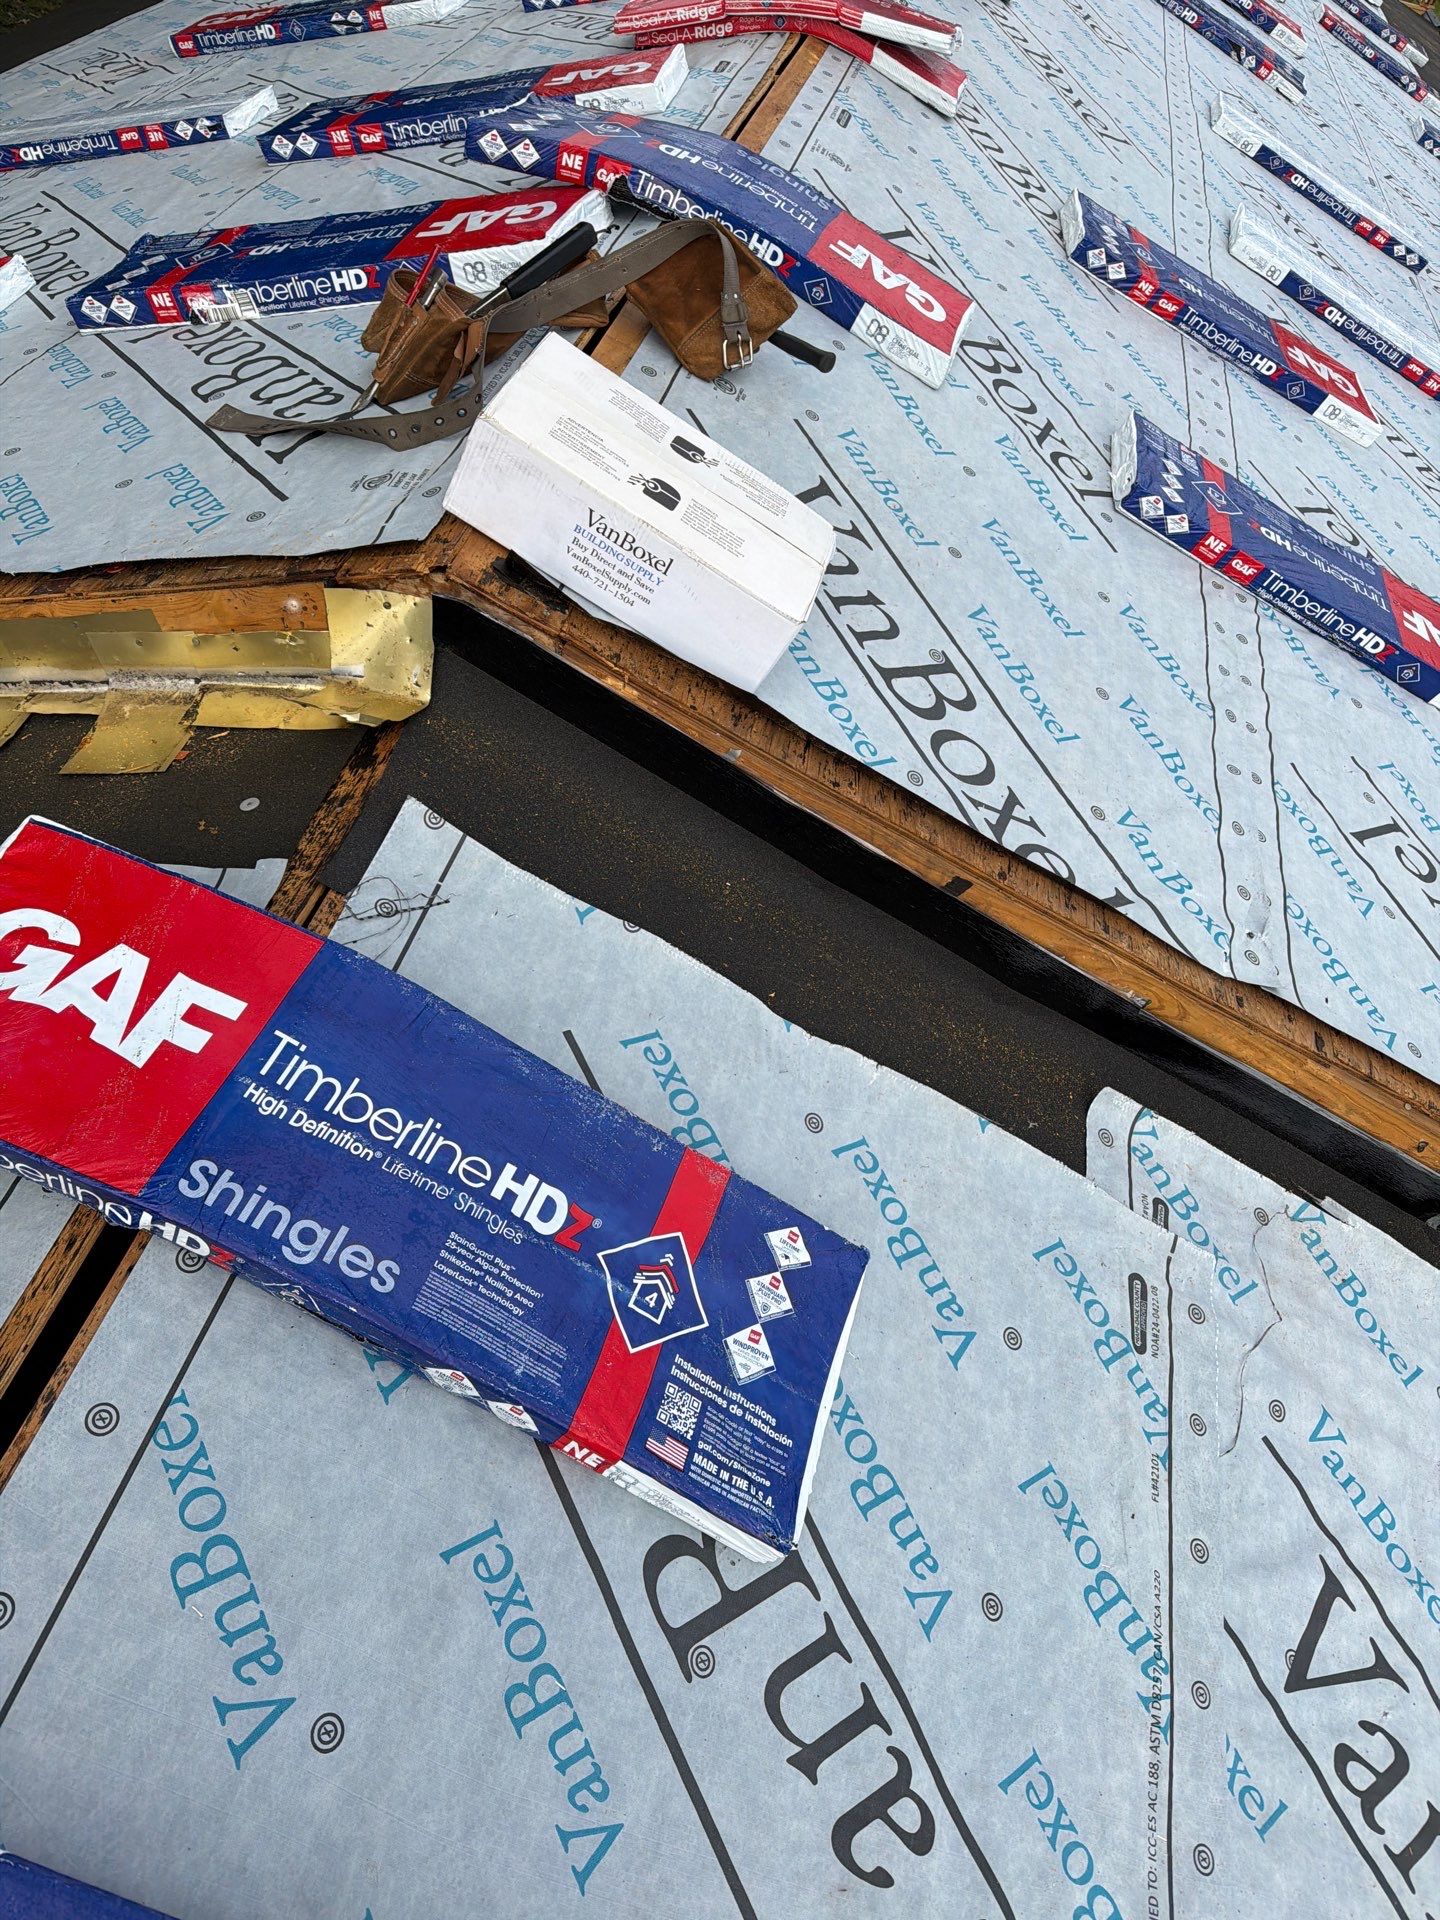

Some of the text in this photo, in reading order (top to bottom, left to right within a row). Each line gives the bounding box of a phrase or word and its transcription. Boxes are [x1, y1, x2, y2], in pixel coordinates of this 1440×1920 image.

[178, 41, 194, 49] GAF
[368, 11, 382, 21] NE
[651, 21, 734, 44] Seal-A-Ridge
[331, 113, 468, 145] NE GAF Timberlin
[561, 152, 583, 170] NE
[596, 168, 622, 188] GA
[930, 158, 999, 233] VanBoxel
[416, 200, 557, 238] GAF
[915, 201, 992, 282] VanBoxel
[151, 292, 172, 307] NE
[828, 239, 947, 322] GAF
[1137, 281, 1155, 295] NE
[1158, 298, 1180, 313] GAF
[866, 318, 890, 345] 08
[1019, 273, 1099, 352] VanBoxel
[1012, 320, 1096, 407] VanBoxel
[863, 350, 958, 458] VanBoxel
[0, 473, 54, 545] VanBoxe
[145, 463, 230, 534] VanBoxel
[836, 427, 942, 549] VanBoxel
[994, 432, 1090, 543] VanBoxel
[571, 536, 655, 594] Buy Direct and Save
[573, 524, 665, 588] BUILDING SUPPLY
[587, 507, 675, 577] VanBoxel
[1204, 534, 1227, 553] NE
[1231, 558, 1257, 578] GAF
[565, 545, 652, 606] VanBoxelSupply.com
[981, 517, 1086, 640] VanBoxel
[966, 603, 1082, 746] VanBoxel
[1273, 778, 1375, 922] VanBoxe
[1115, 806, 1231, 962] VanBoxe
[0, 908, 248, 1068] GAF
[243, 1081, 288, 1120] High
[453, 1191, 524, 1245] Shingles
[178, 1158, 400, 1293] Shingles
[448, 1231, 494, 1261] StainGuard
[831, 1135, 978, 1371] VanBoxel
[443, 1239, 475, 1261] 25-year
[473, 1256, 500, 1275] Algae
[475, 1285, 525, 1317] Technology
[482, 1274, 514, 1297] Nailing
[513, 1292, 535, 1308] Area
[645, 1291, 659, 1308] 4
[756, 1280, 787, 1303] STAINGUARD
[758, 1287, 782, 1306] PLUS PRO
[1287, 1200, 1424, 1389] VanBoxel
[732, 1337, 770, 1362] WINDPROVEN
[671, 1365, 727, 1408] Instrucciones
[729, 1404, 743, 1416] de
[745, 1412, 793, 1448] instalación
[674, 1354, 777, 1427] Installation instructions
[563, 1441, 605, 1468] NE
[693, 1452, 775, 1508] MADE IN THE U.S.A.
[828, 1376, 953, 1641] VanBox
[439, 1518, 625, 1897] VanBoxel
[1147, 1759, 1160, 1786] 188,
[1147, 1791, 1158, 1812] AC
[1145, 1815, 1158, 1862] ICC-ES
